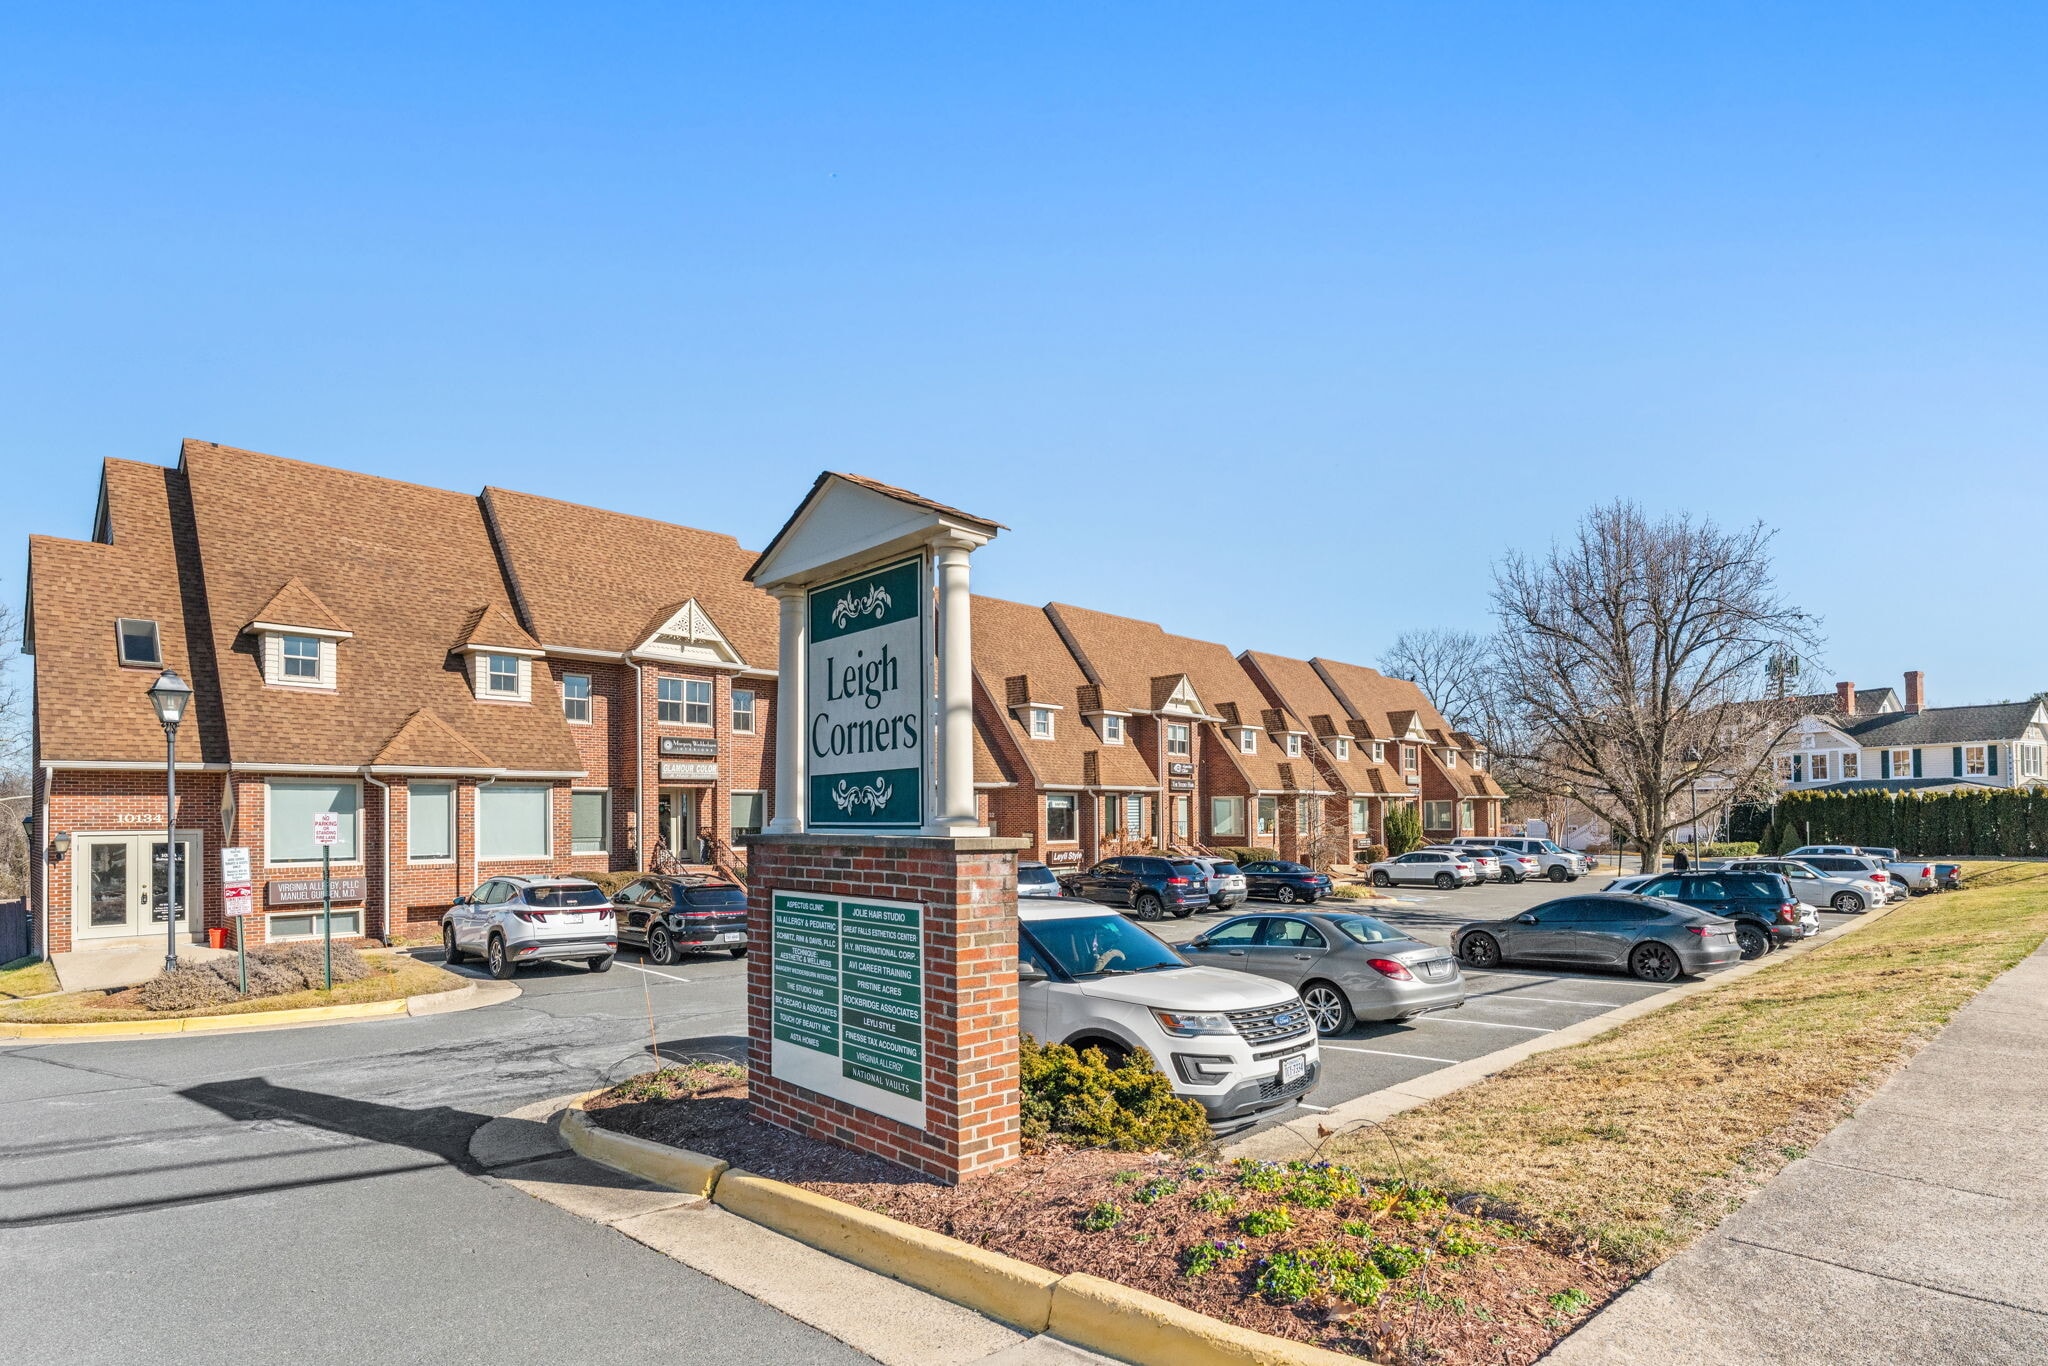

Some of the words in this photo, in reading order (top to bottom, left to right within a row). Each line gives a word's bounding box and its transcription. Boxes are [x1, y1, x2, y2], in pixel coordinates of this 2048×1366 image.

[827, 643, 898, 709] Leigh
[812, 713, 917, 758] Corners
[663, 764, 694, 773] GLAMOUR
[696, 764, 717, 773] COLOR
[117, 814, 162, 823] 10134
[1067, 851, 1083, 862] Style
[277, 882, 308, 892] VIRGINIA
[309, 881, 341, 891] ALLEGY,
[342, 880, 360, 889] PLLC
[280, 891, 310, 901] MANUEL
[342, 889, 357, 898] M.D.
[787, 901, 809, 910] ASPECTUS
[810, 903, 824, 911] CLINIC
[776, 915, 782, 924] VA
[783, 916, 805, 926] ALLERGY
[810, 920, 837, 931] PEDIATRIC
[852, 908, 868, 918] JOLIE
[868, 909, 883, 919] HAIR
[883, 912, 906, 922] STUDIO
[842, 925, 857, 934] GREAT
[857, 926, 872, 936] FALLS
[872, 928, 896, 940] ESTHETICS
[896, 932, 917, 942] CENTER
[823, 939, 836, 948] PLLC
[844, 943, 855, 951] H.Y.
[854, 944, 897, 958] INTERNATIONAL
[898, 950, 917, 960] CORP.
[780, 952, 803, 962] AESTHETIC
[807, 957, 832, 968] WELLNESS
[816, 973, 837, 982] INTERIORS
[848, 961, 858, 970] AVI
[858, 962, 882, 974] CAREER
[882, 966, 912, 980] TRAINING
[786, 982, 796, 990] THE
[796, 984, 812, 994] STUDIO
[813, 987, 824, 997] HAIR
[857, 980, 881, 992] PRISTINE
[882, 985, 902, 996] ACRES
[783, 997, 802, 1009] DECARO
[803, 1002, 806, 1010] &
[807, 1003, 837, 1018] ASSOCIATES
[843, 995, 880, 1011] ROCKBRIDGE
[880, 1003, 919, 1019] ASSOCIATES
[780, 1013, 795, 1024] TOUCH
[795, 1017, 802, 1025] OF
[802, 1020, 821, 1030] BEAUTY
[822, 1024, 832, 1034] INC.
[878, 1021, 896, 1033] STYLE
[790, 1033, 801, 1042] ASTA
[802, 1036, 820, 1048] HOMES
[845, 1030, 867, 1044] FINESSE
[867, 1037, 878, 1047] TAX
[879, 1041, 917, 1057] ACCOUNTING
[856, 1052, 879, 1065] VIRGINIA
[880, 1058, 904, 1072] ALLERGY
[852, 1067, 883, 1085] NATIONAL
[885, 1077, 910, 1093] VAULTS
